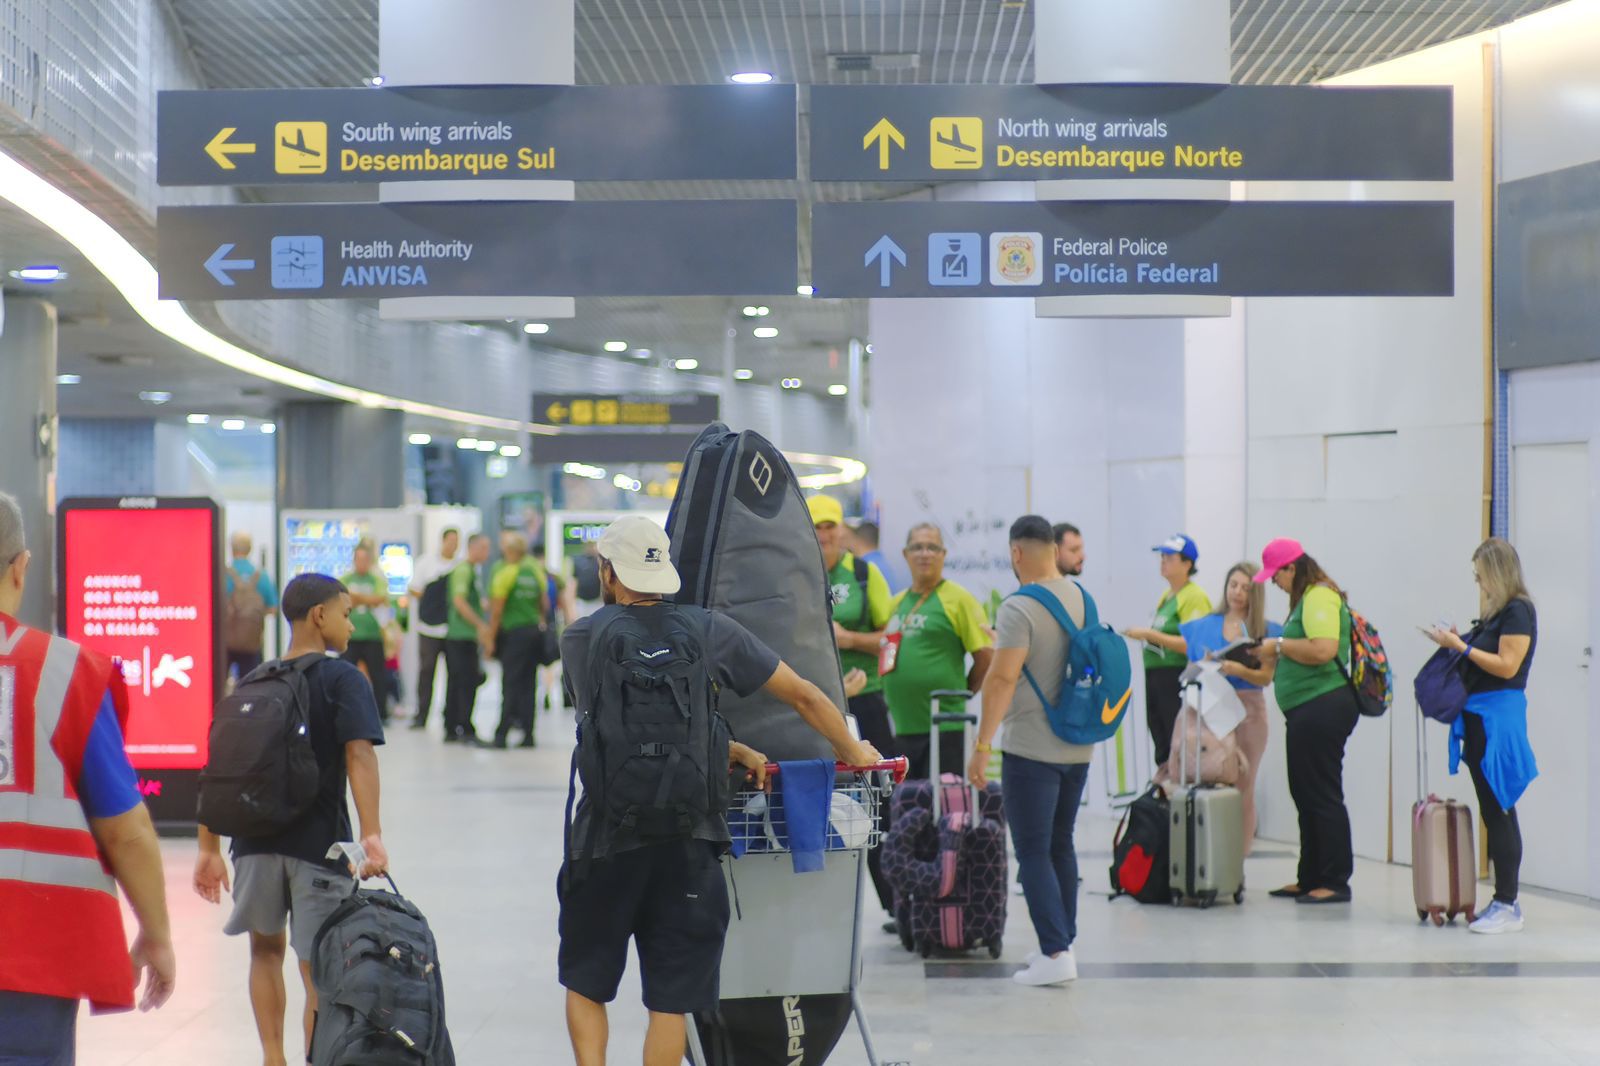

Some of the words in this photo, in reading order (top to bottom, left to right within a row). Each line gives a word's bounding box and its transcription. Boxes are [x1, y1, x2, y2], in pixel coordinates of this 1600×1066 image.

[342, 121, 395, 143] South
[400, 122, 443, 146] wing
[448, 120, 513, 141] arrivals
[998, 117, 1050, 139] North
[1055, 118, 1097, 142] wing
[1102, 117, 1168, 138] arrivals
[341, 149, 509, 174] Desembarque
[518, 148, 555, 170] Sul
[998, 145, 1165, 172] Desembarque
[1175, 145, 1243, 168] Norte
[341, 240, 394, 259] Health
[399, 239, 473, 262] Authority
[1053, 238, 1113, 256] Federal
[1119, 238, 1168, 256] Police
[342, 264, 428, 286] ANVISA
[1053, 262, 1128, 285] Polícia
[1135, 262, 1219, 285] Federal
